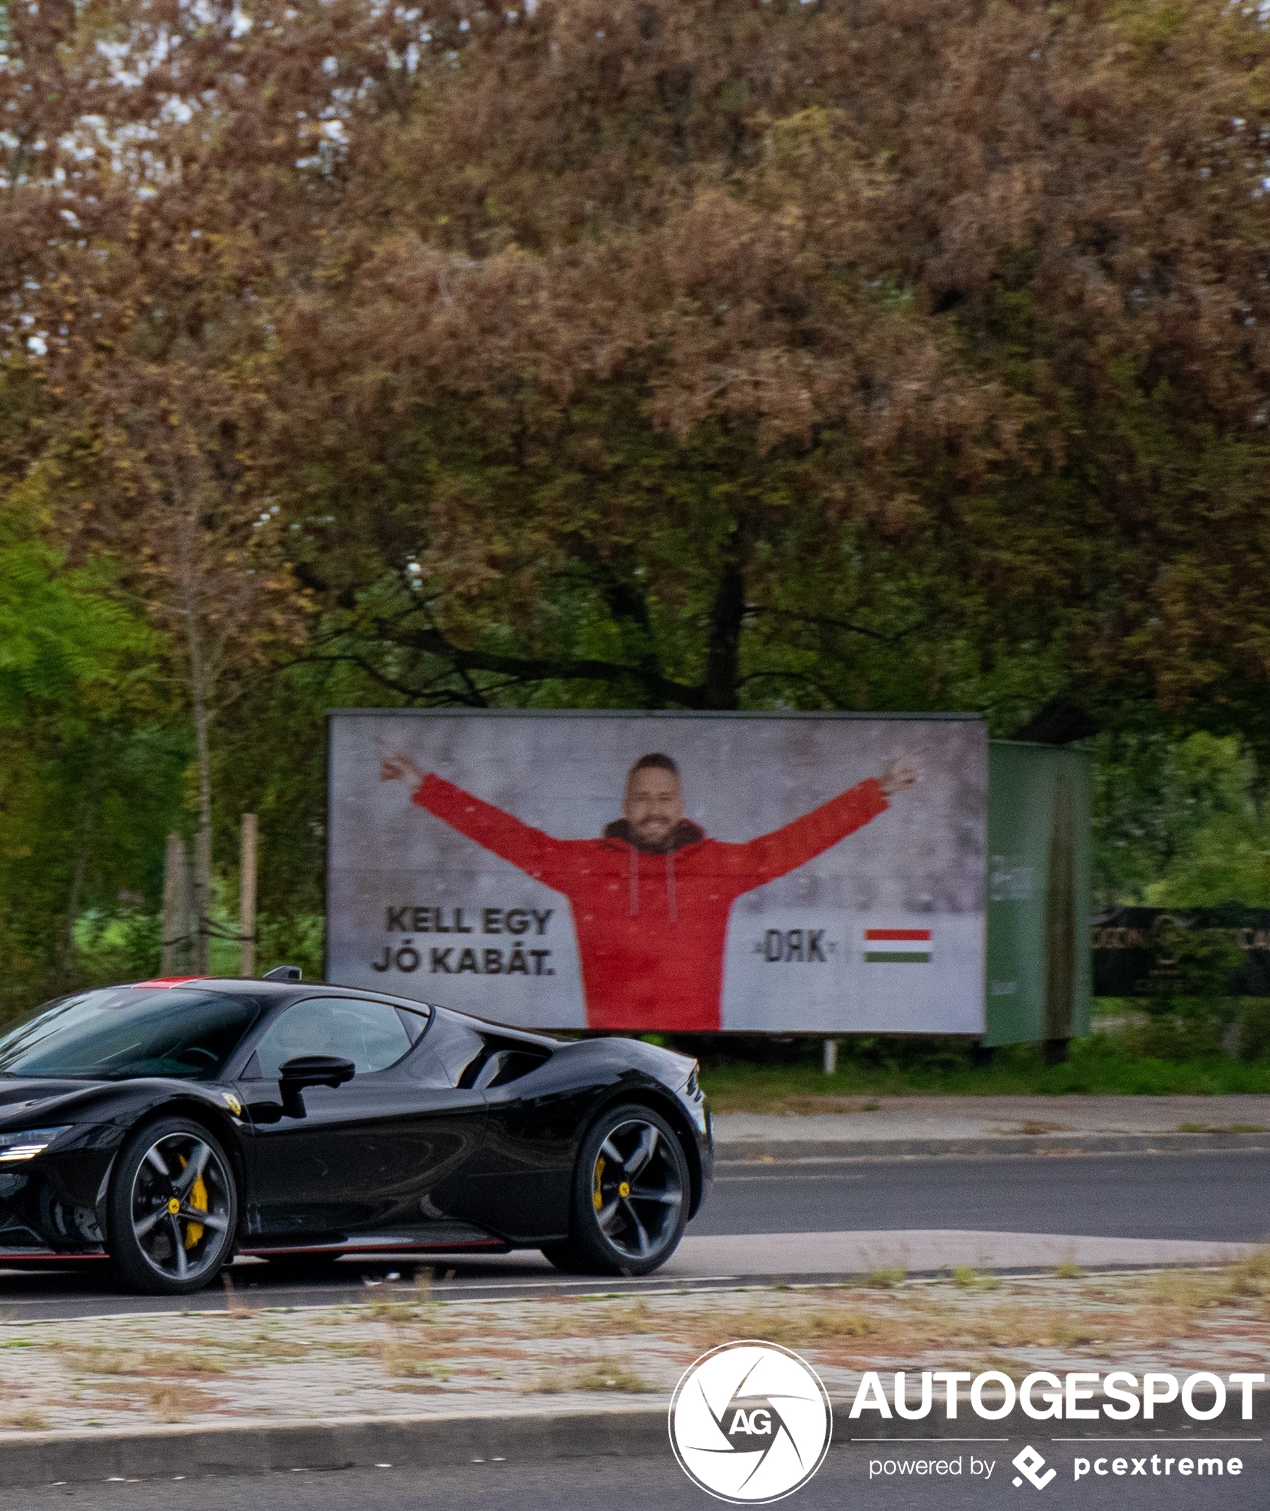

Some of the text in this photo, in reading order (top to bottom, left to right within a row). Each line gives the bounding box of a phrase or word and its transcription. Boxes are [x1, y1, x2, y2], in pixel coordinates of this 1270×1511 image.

[386, 906, 555, 935] KELL EGY
[371, 938, 556, 976] JÓ KABÁT.
